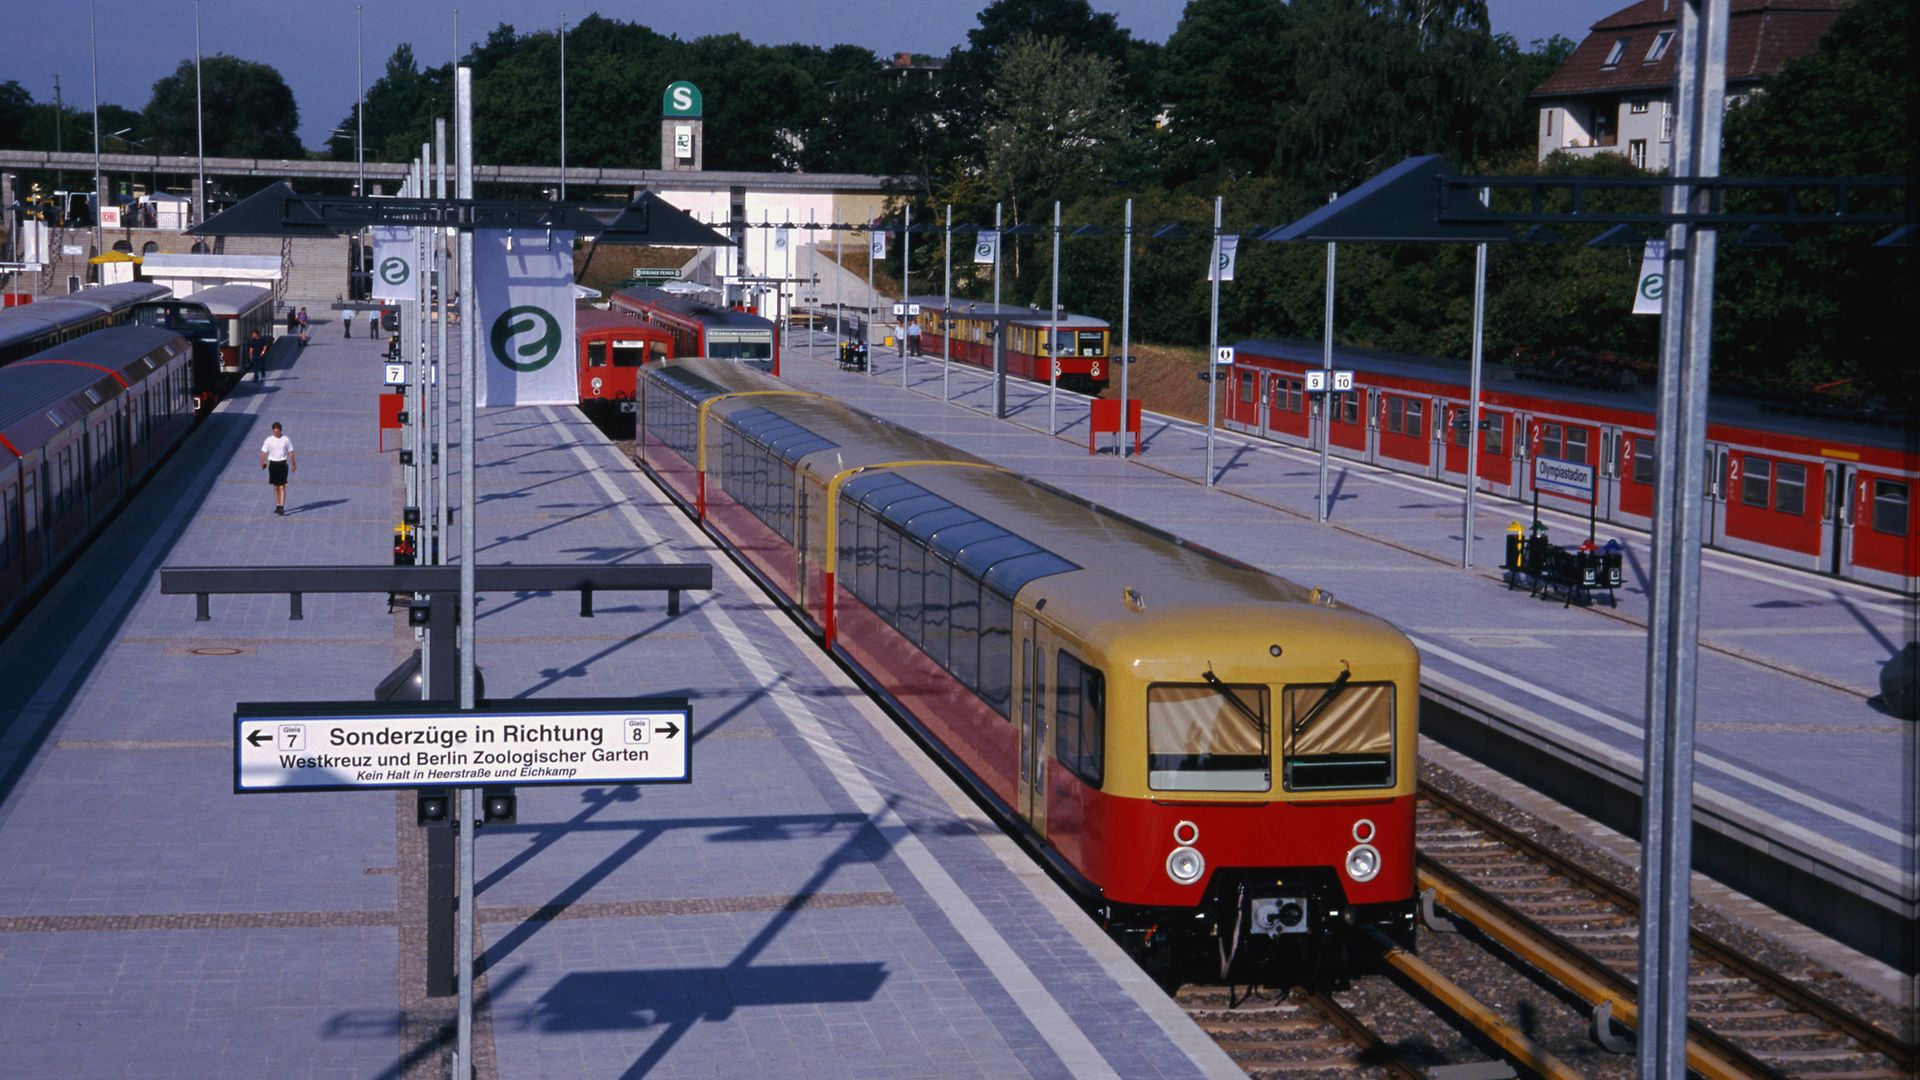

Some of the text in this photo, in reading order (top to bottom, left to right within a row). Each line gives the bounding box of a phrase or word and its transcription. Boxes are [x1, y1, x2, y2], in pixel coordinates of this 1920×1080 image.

[673, 86, 692, 111] S
[391, 371, 399, 381] 7
[1312, 378, 1319, 388] 9
[1337, 378, 1350, 388] 10
[1271, 379, 1276, 393] 2
[1381, 399, 1387, 414] 2
[1449, 410, 1454, 426] 2
[1533, 425, 1540, 442] 2
[1624, 441, 1631, 459] 2
[1540, 461, 1588, 483] Olympiastadion
[1730, 460, 1738, 480] 2
[1859, 481, 1867, 503] 1
[287, 734, 297, 748] 7
[330, 724, 603, 748] Sonderzüge in Richtung
[633, 728, 642, 741] 8
[279, 748, 648, 769] Westkreuz und Berlin Zoologischer Garten
[356, 767, 577, 781] Kein Halt in Heerstraße und Eichkamp
